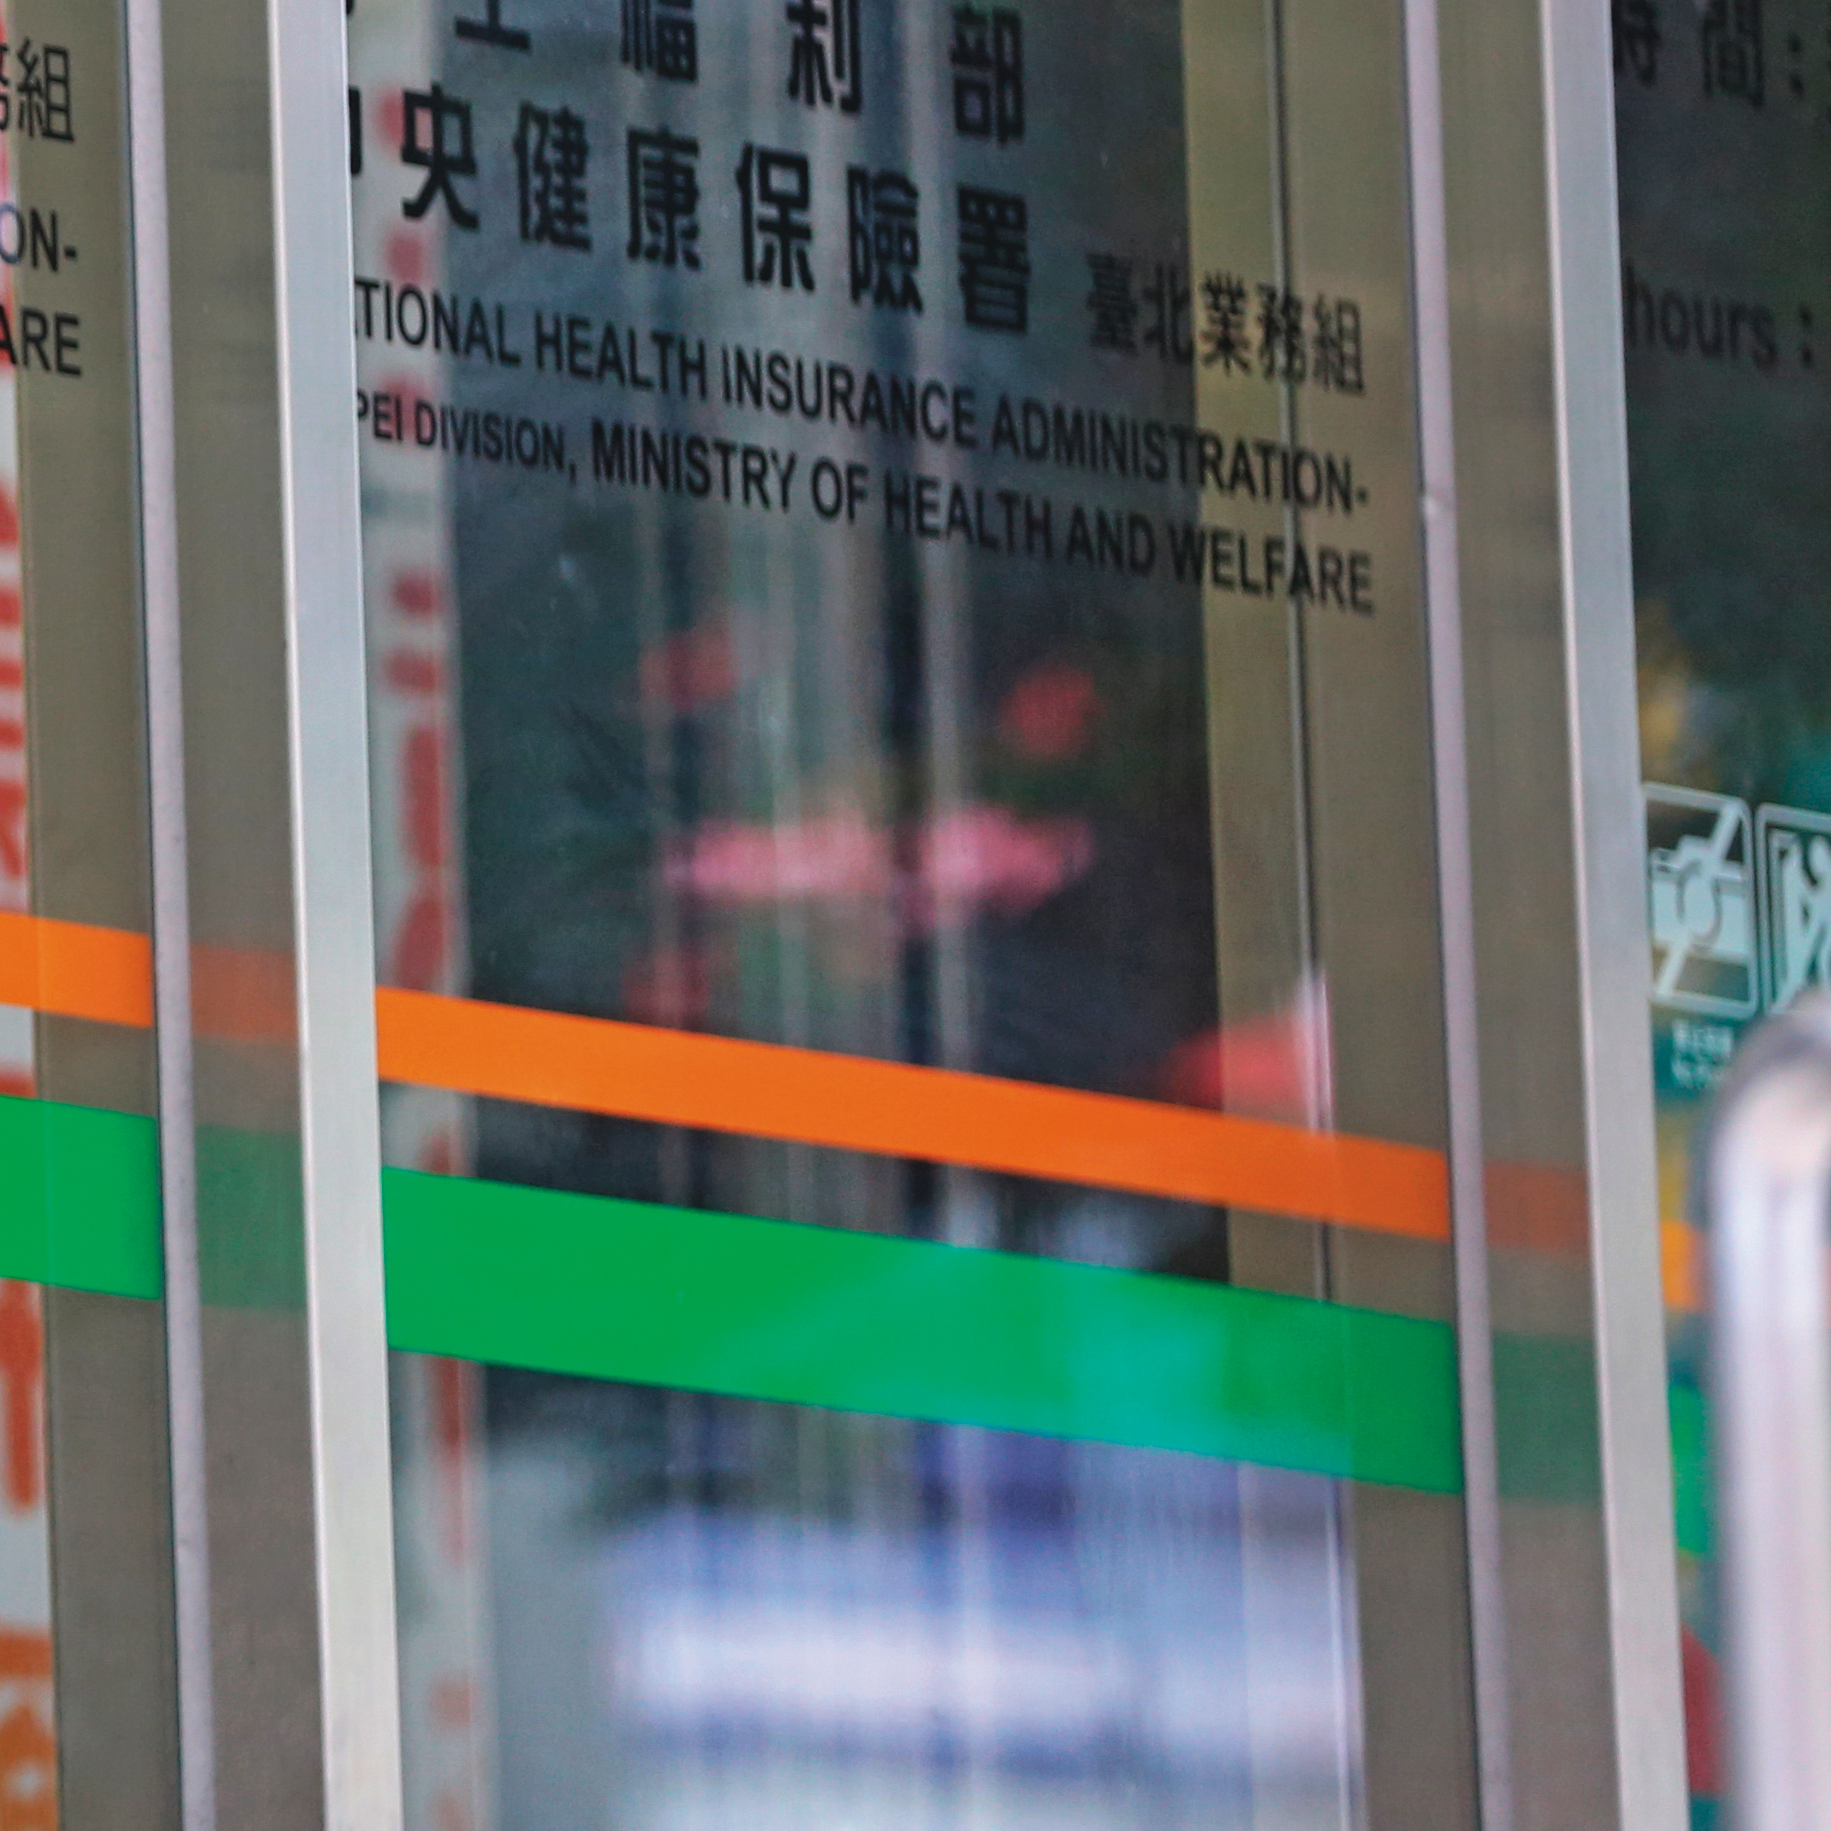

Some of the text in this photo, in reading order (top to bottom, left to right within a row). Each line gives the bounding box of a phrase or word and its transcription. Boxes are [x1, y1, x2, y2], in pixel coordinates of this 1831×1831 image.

[348, 80, 1030, 335] 央健康保險署
[355, 277, 521, 365] TIONAL
[537, 310, 706, 399] HEALTH
[723, 345, 976, 447] INSURANCE
[415, 401, 577, 482] DIVISION,
[592, 417, 798, 512] MINISTRY
[811, 457, 868, 524] OF
[884, 473, 1052, 560] HEALTH
[1066, 510, 1154, 577] AND
[1168, 521, 1374, 615] WELFARE
